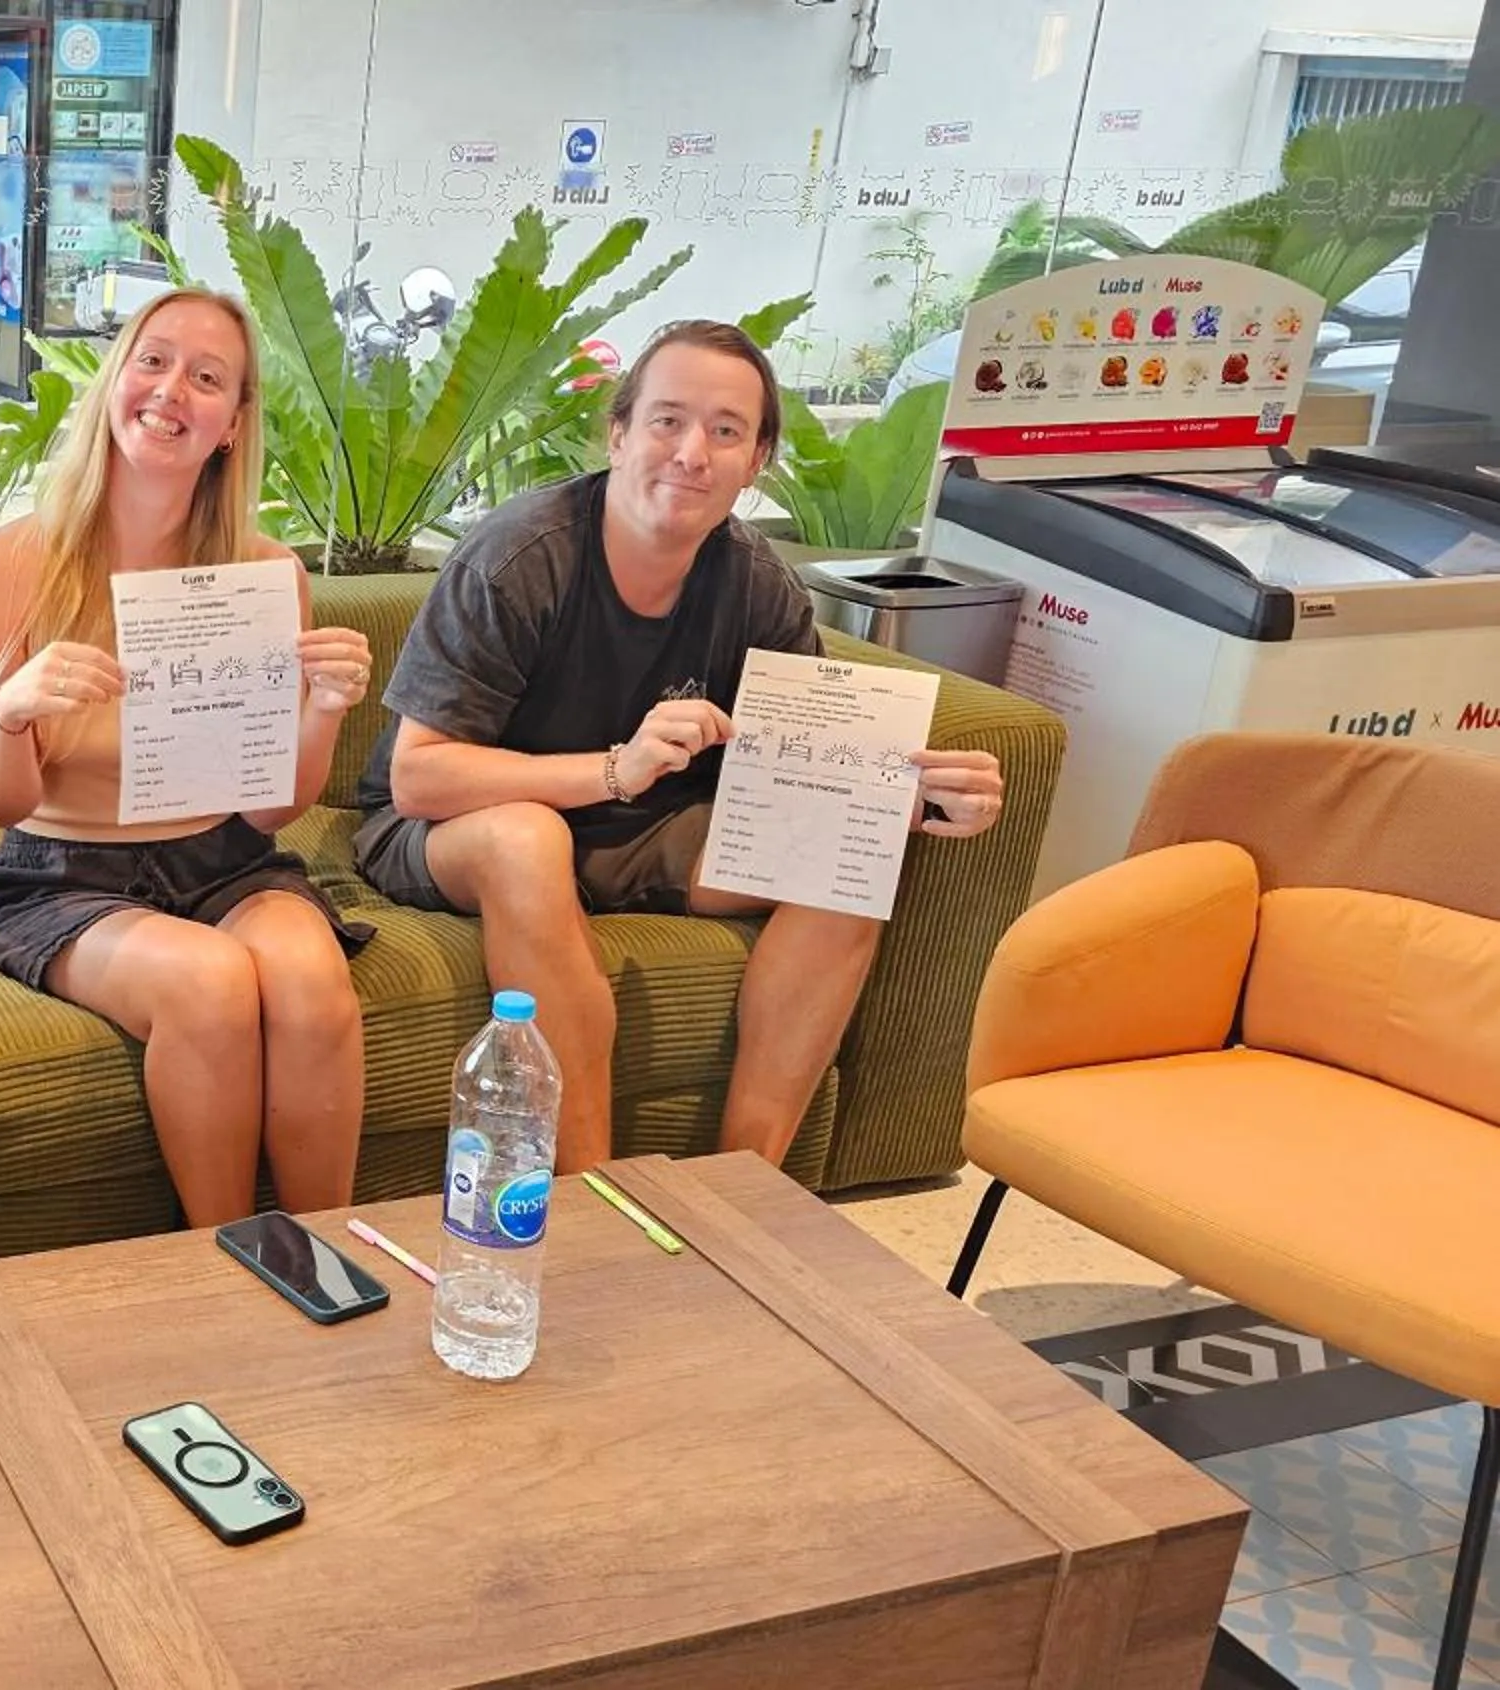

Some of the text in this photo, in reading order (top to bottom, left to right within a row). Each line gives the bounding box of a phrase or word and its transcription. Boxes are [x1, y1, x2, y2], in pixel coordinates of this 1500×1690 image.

[1098, 277, 1203, 294] Lub d Muse
[1038, 593, 1089, 625] Muse
[1456, 702, 1500, 731] Mu
